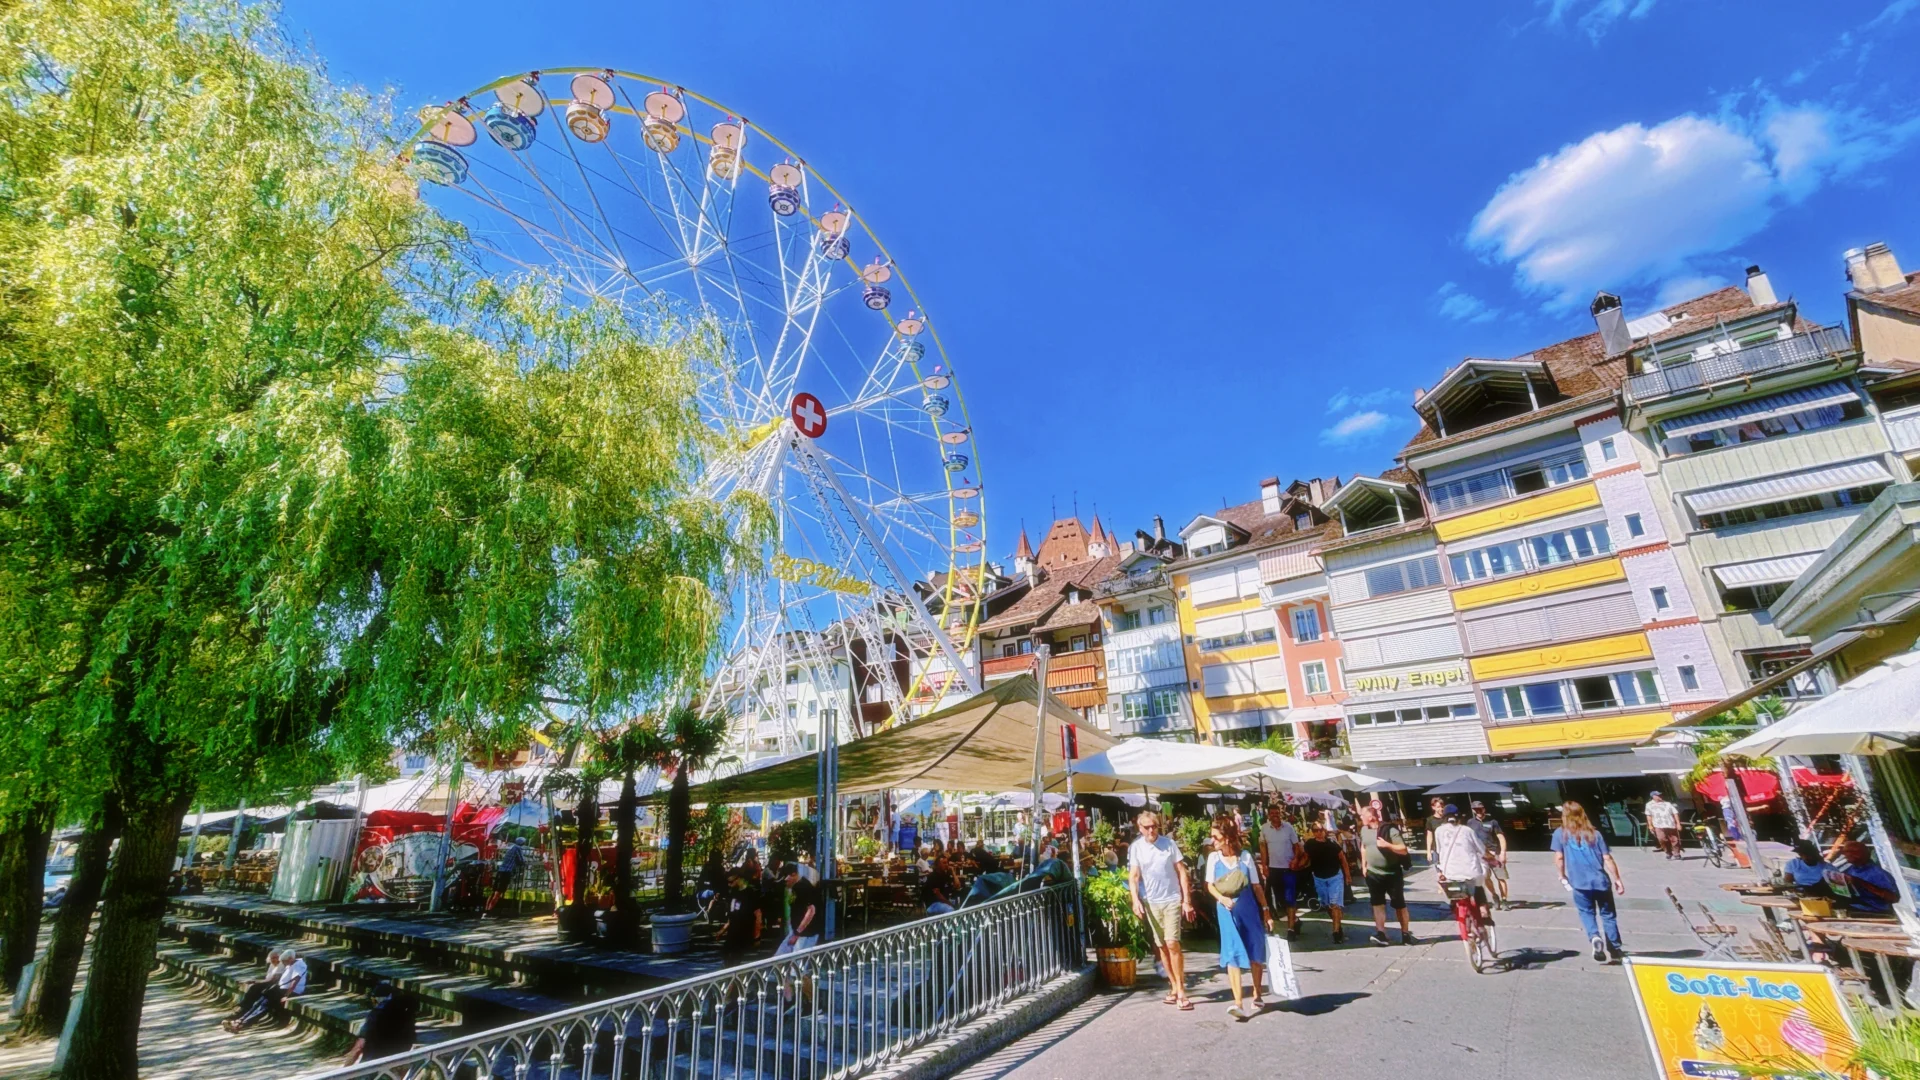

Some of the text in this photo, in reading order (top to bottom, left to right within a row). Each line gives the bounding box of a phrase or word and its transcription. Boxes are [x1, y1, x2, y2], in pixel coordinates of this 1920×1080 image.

[1356, 667, 1464, 691] Willy Engel
[1666, 972, 1803, 1001] Soft-Ice
